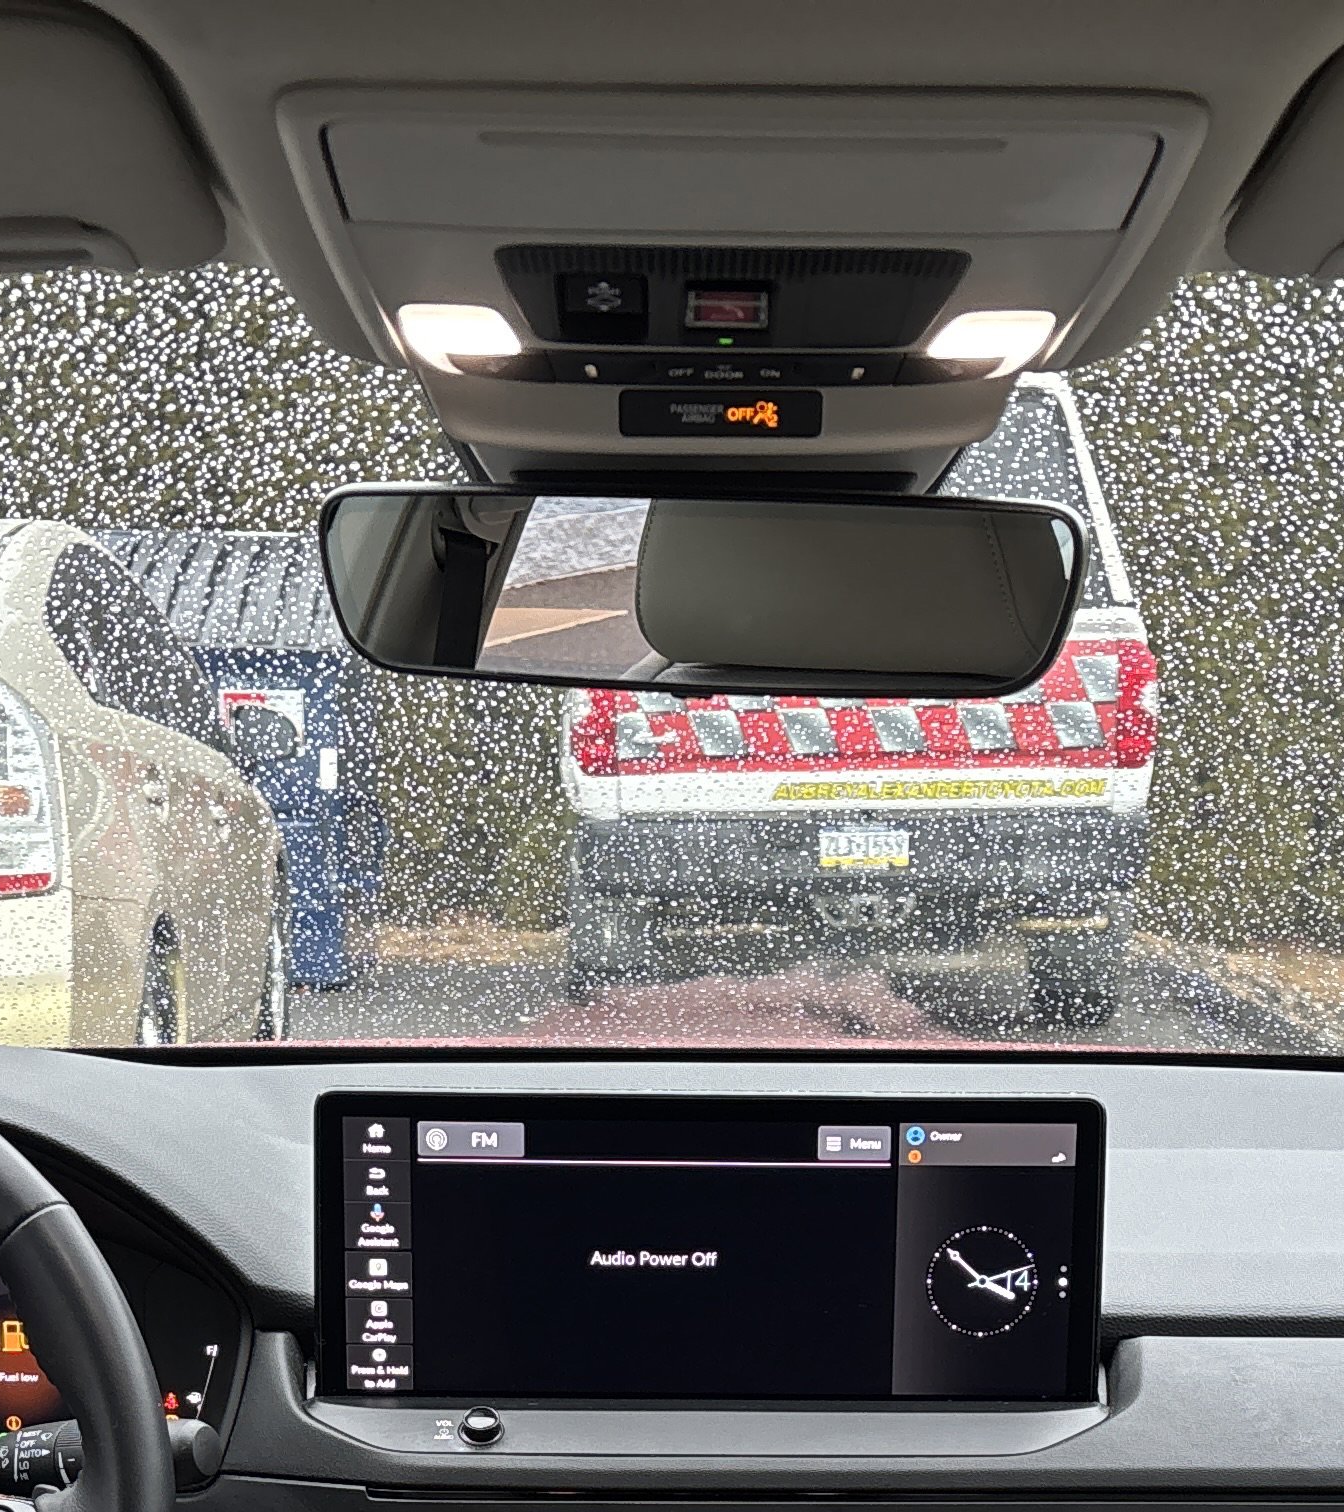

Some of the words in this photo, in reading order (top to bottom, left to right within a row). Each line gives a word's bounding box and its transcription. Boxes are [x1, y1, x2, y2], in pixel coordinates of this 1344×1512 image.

[727, 407, 755, 421] OFF
[471, 1131, 498, 1148] FM
[930, 1131, 963, 1142] Owner
[362, 1143, 392, 1153] Home
[850, 1138, 882, 1150] Menu
[365, 1185, 389, 1196] Back
[360, 1223, 395, 1234] Google
[590, 1250, 636, 1266] Audio
[639, 1251, 688, 1266] Power
[691, 1251, 718, 1266] Off
[348, 1279, 382, 1290] Google
[383, 1280, 409, 1290] Maps
[386, 1366, 409, 1375] Hold
[0, 1373, 20, 1383] Fuel
[20, 1373, 39, 1383] low
[376, 1378, 396, 1388] Add
[20, 1440, 36, 1449] OFF
[18, 1449, 42, 1459] AUTO
[18, 1461, 30, 1470] LO
